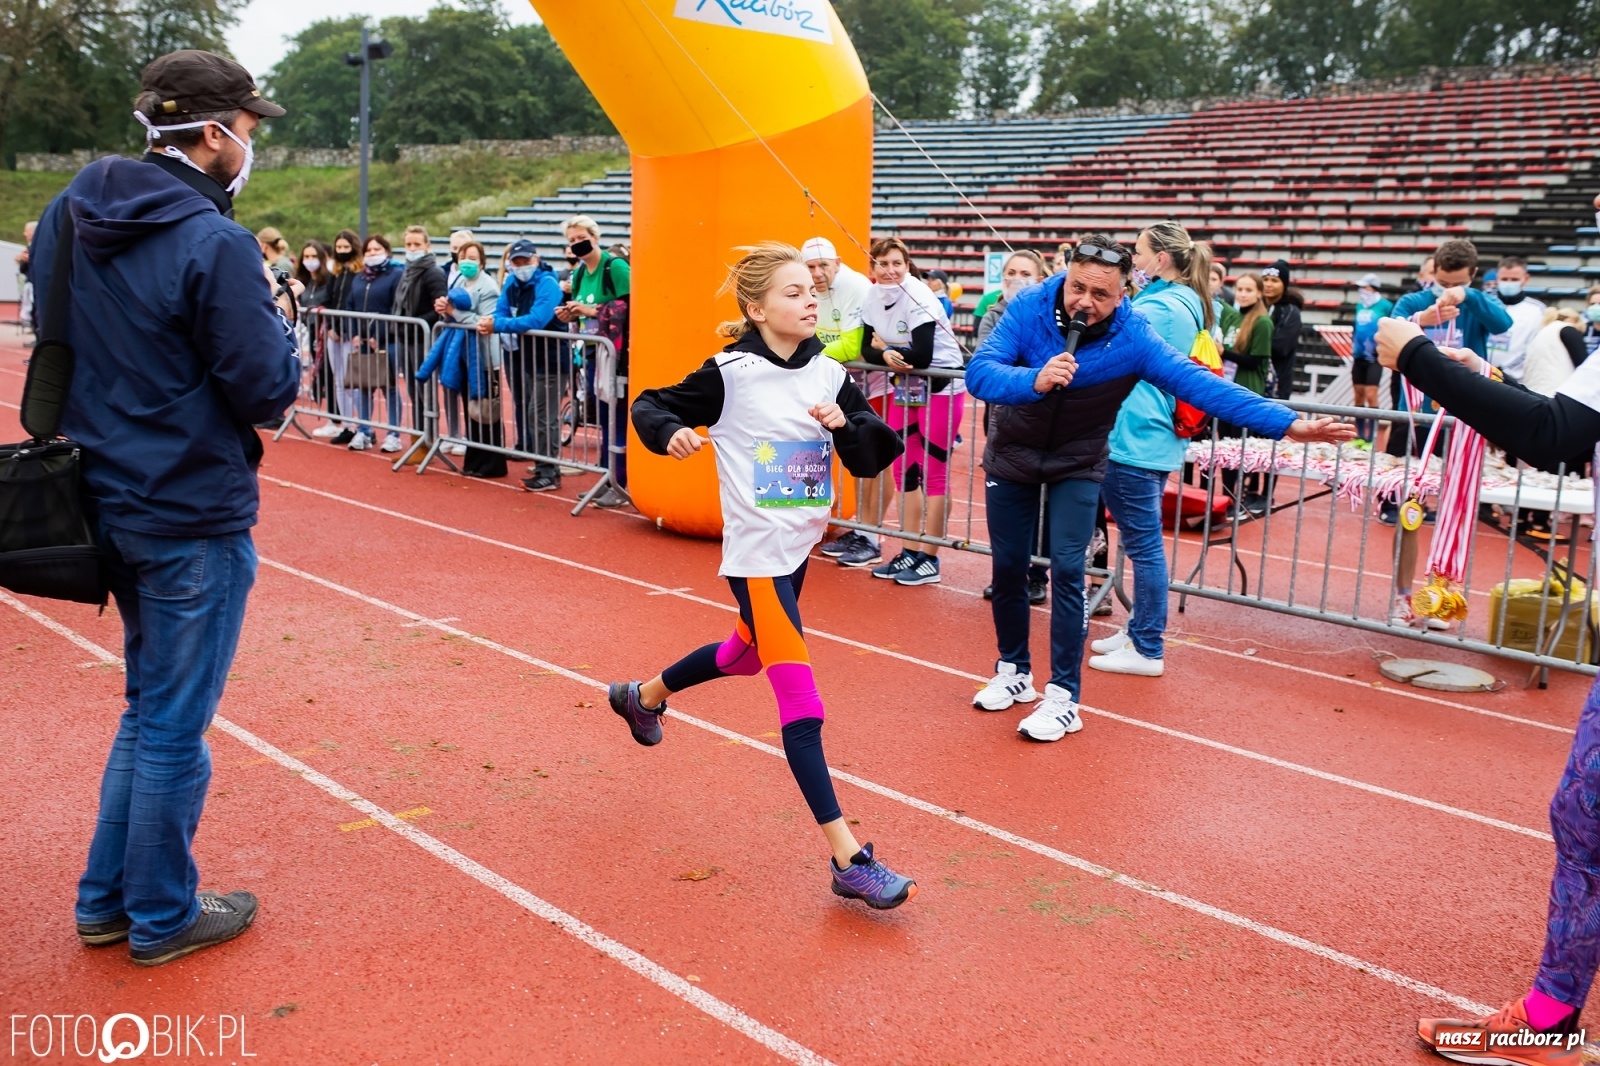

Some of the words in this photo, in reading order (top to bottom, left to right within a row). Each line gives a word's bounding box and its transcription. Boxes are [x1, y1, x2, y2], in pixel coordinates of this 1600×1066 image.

[765, 464, 784, 473] BIEG
[787, 464, 802, 473] DLA
[804, 482, 826, 498] 026
